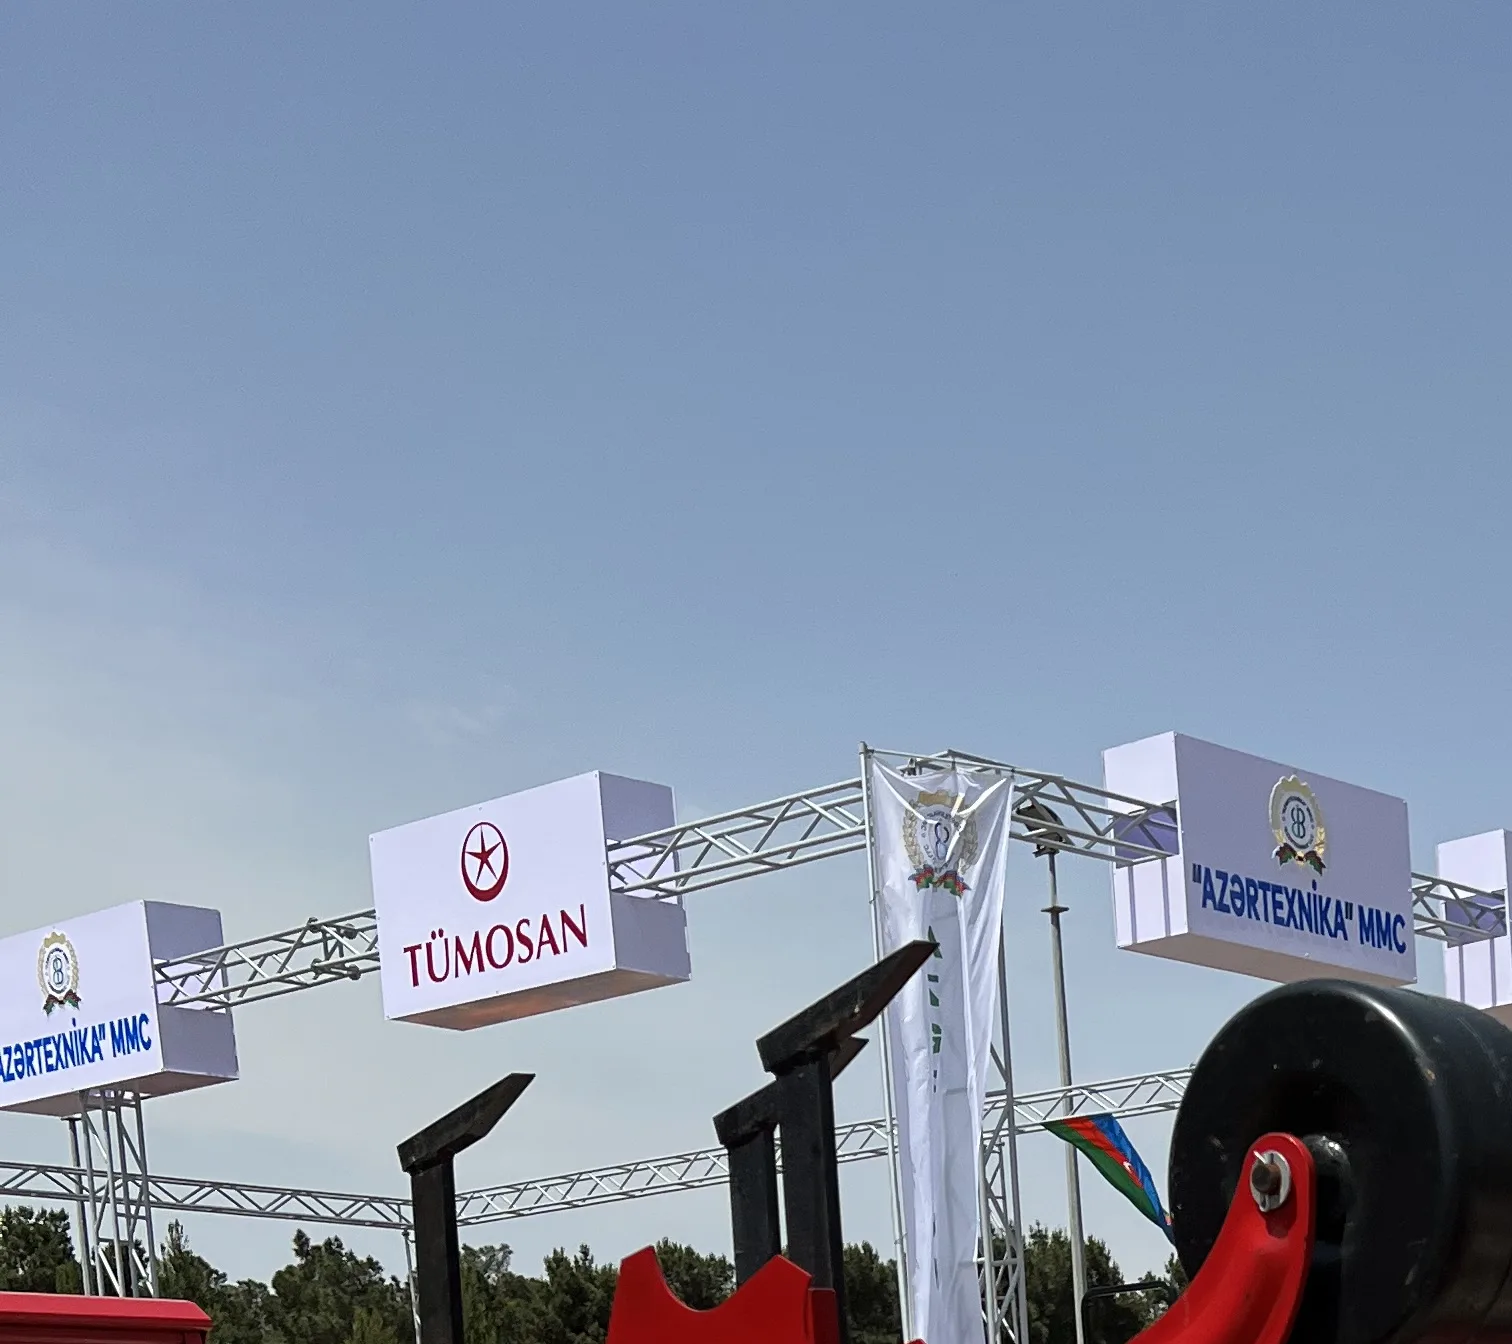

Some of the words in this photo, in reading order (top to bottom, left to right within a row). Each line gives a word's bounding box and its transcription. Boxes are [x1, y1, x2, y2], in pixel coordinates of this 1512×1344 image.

[403, 904, 588, 987] TÜMOSAN
[1192, 863, 1353, 941] "AZƏRTEXNİKA"
[1358, 905, 1407, 954] MMC
[0, 1017, 106, 1082] ZƏRTEXNİKA"
[109, 1013, 152, 1058] MMC
